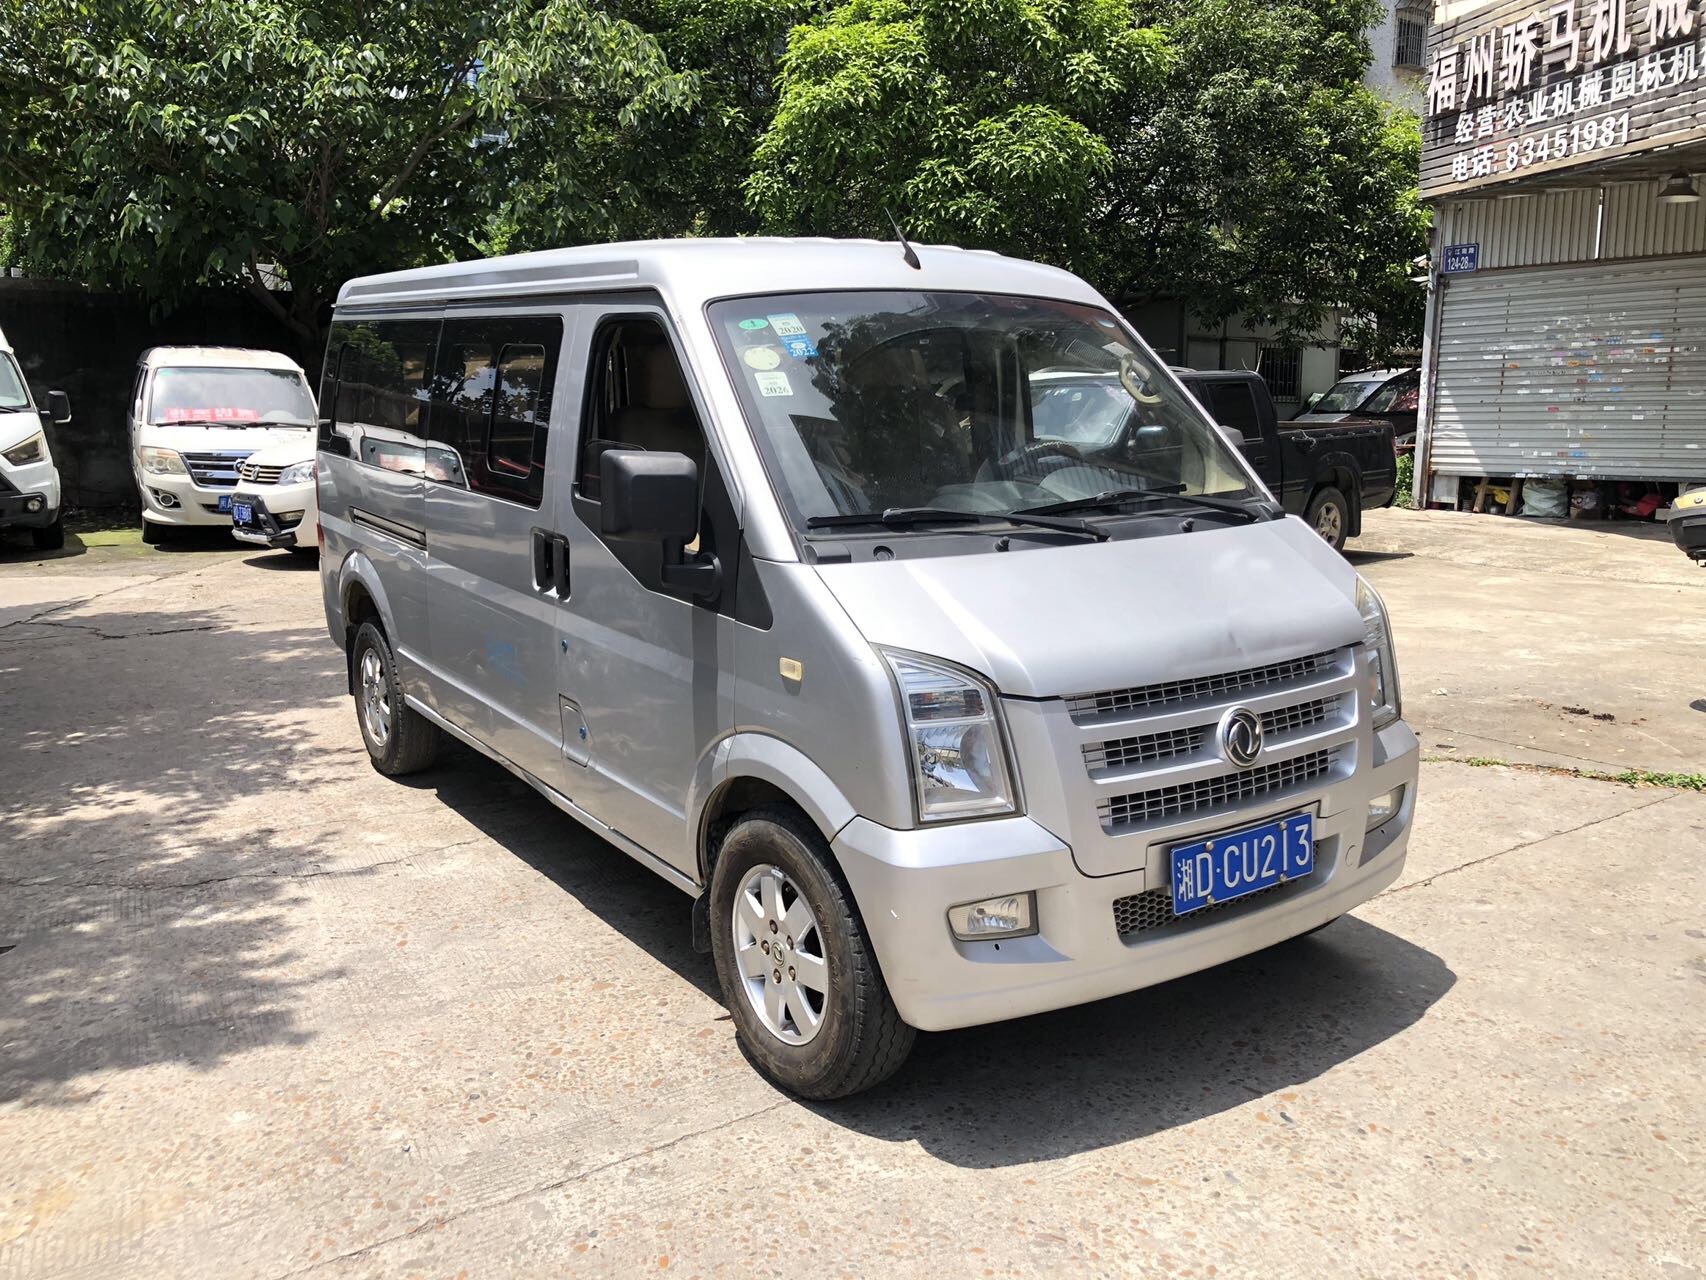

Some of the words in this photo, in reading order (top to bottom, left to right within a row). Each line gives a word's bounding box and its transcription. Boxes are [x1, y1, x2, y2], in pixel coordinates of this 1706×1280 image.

[1427, 0, 1694, 117] 福州骄马机械
